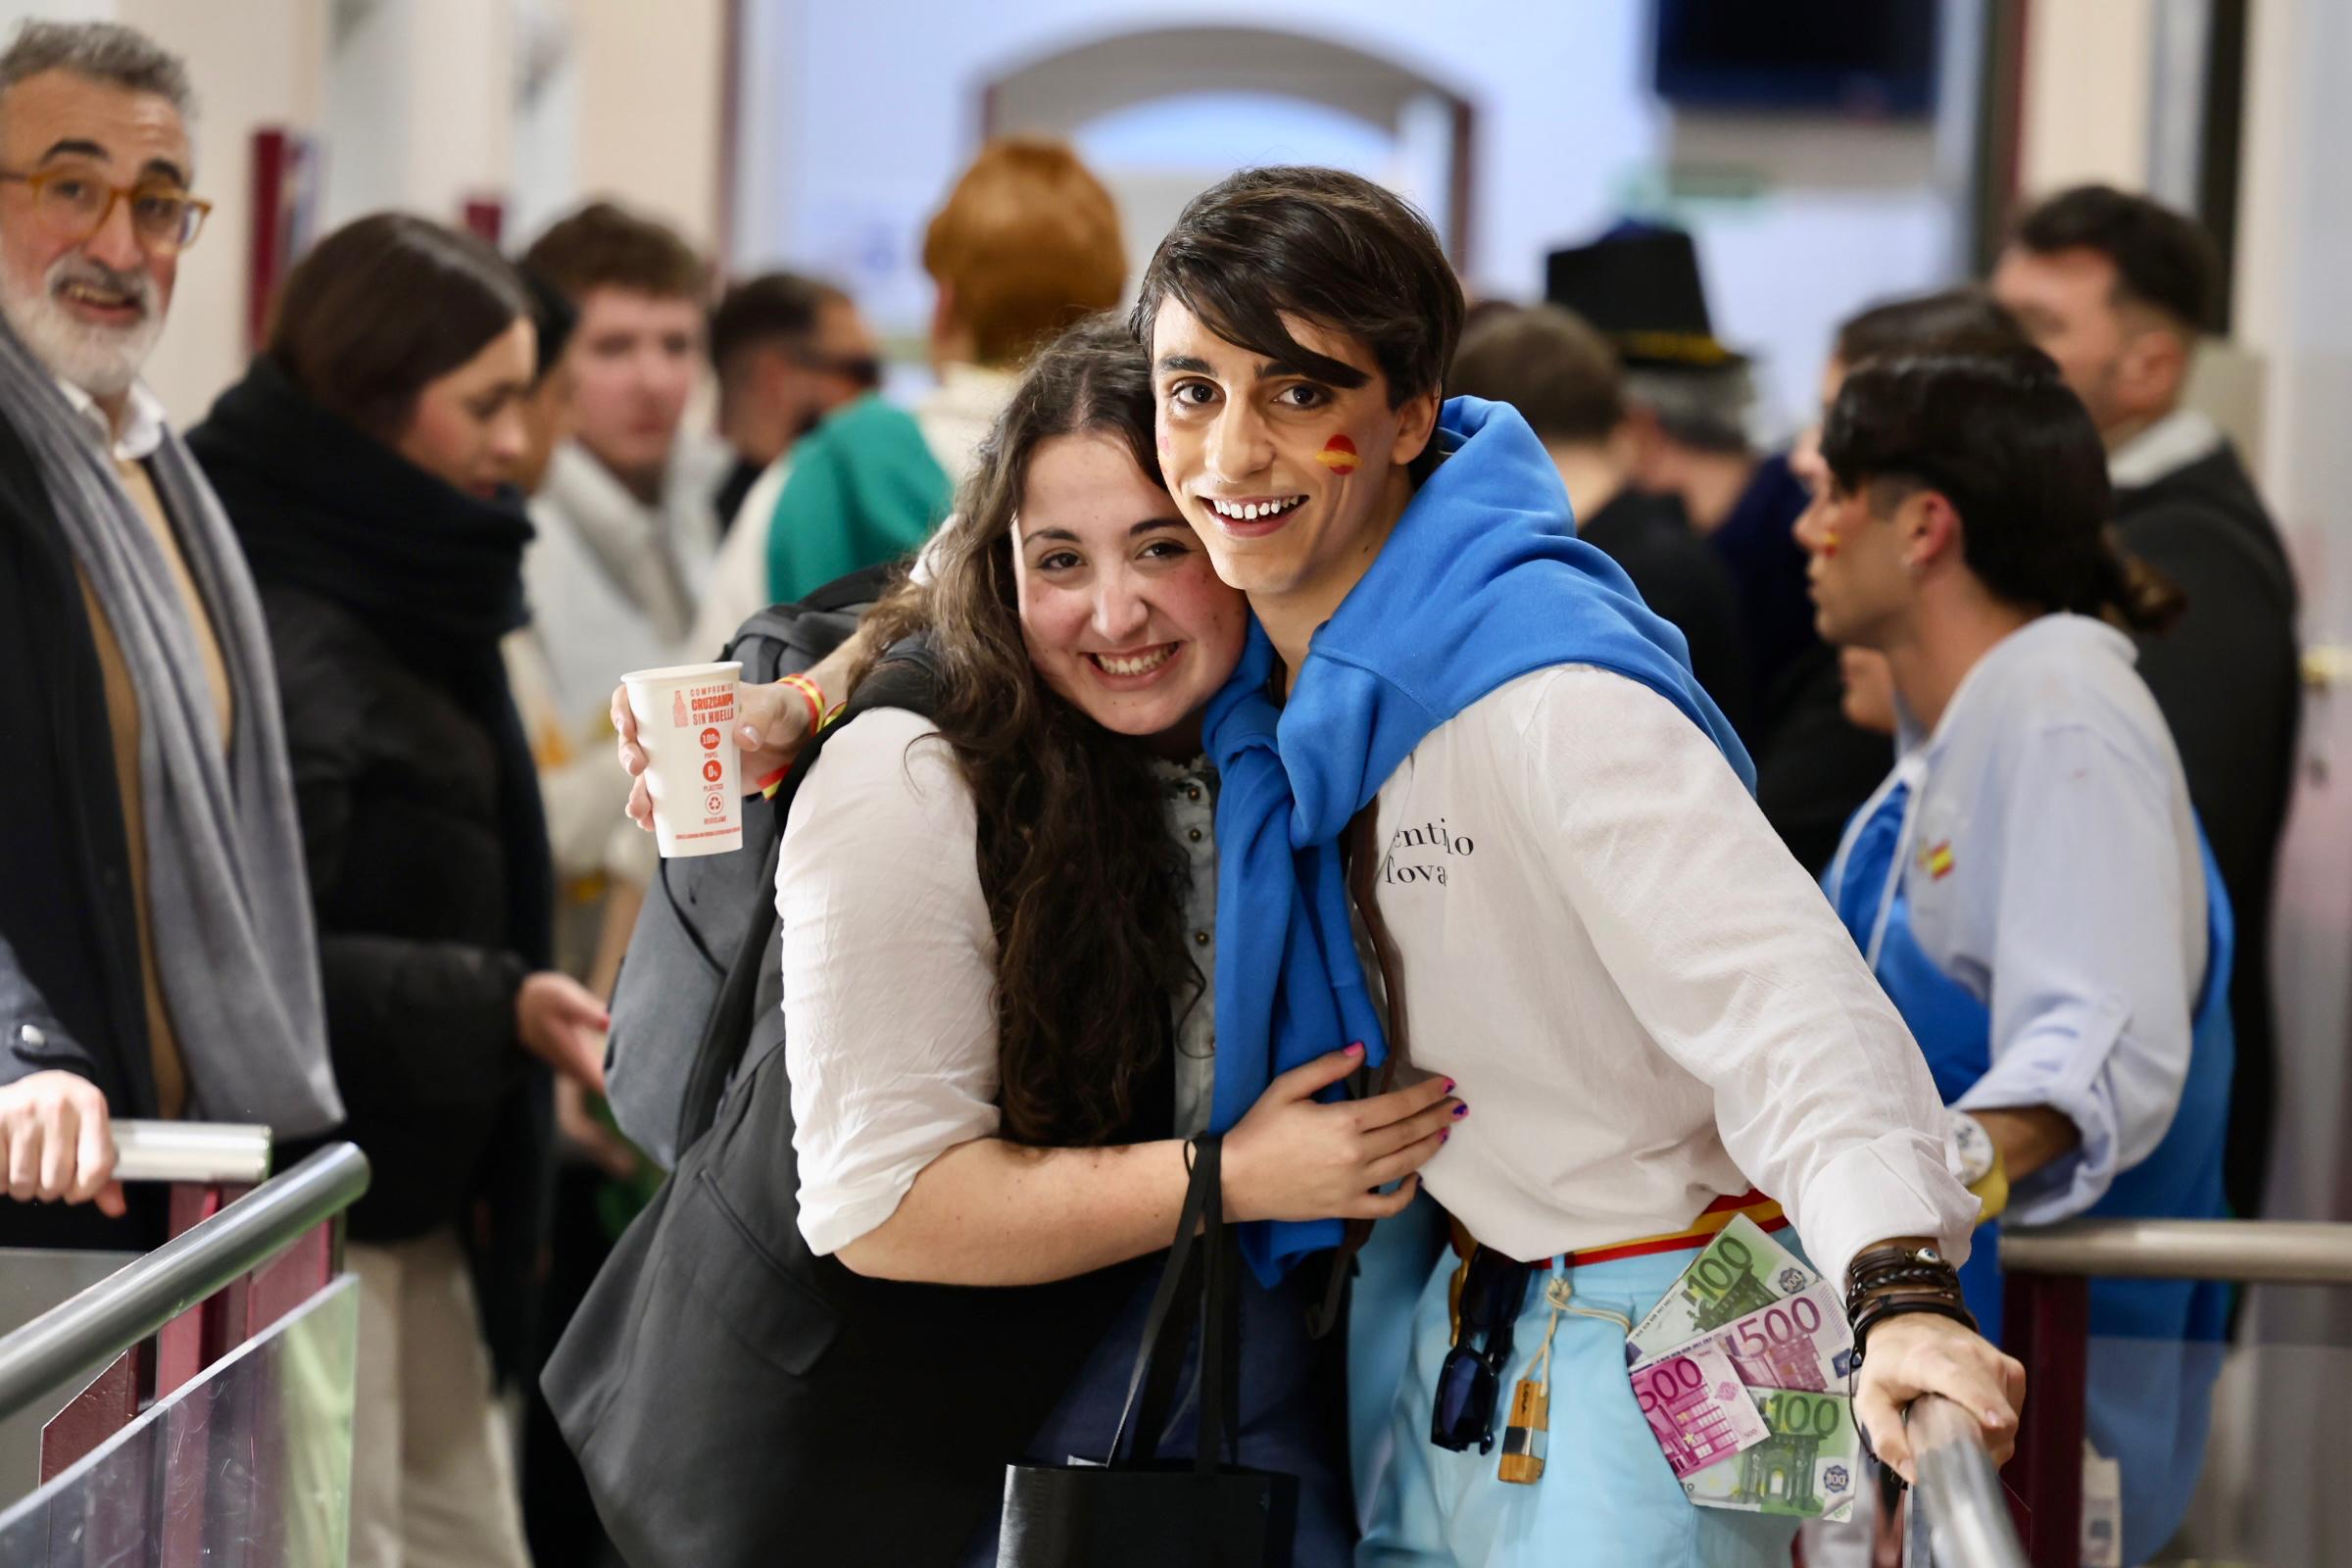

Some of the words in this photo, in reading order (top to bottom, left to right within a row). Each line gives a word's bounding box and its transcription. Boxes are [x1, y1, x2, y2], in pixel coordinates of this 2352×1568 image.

[693, 712, 706, 726] SIN
[1687, 1237, 1753, 1302] 100
[1738, 1297, 1821, 1358] 500
[1768, 1394, 1839, 1436] 100
[1827, 1473, 1847, 1486] 100
